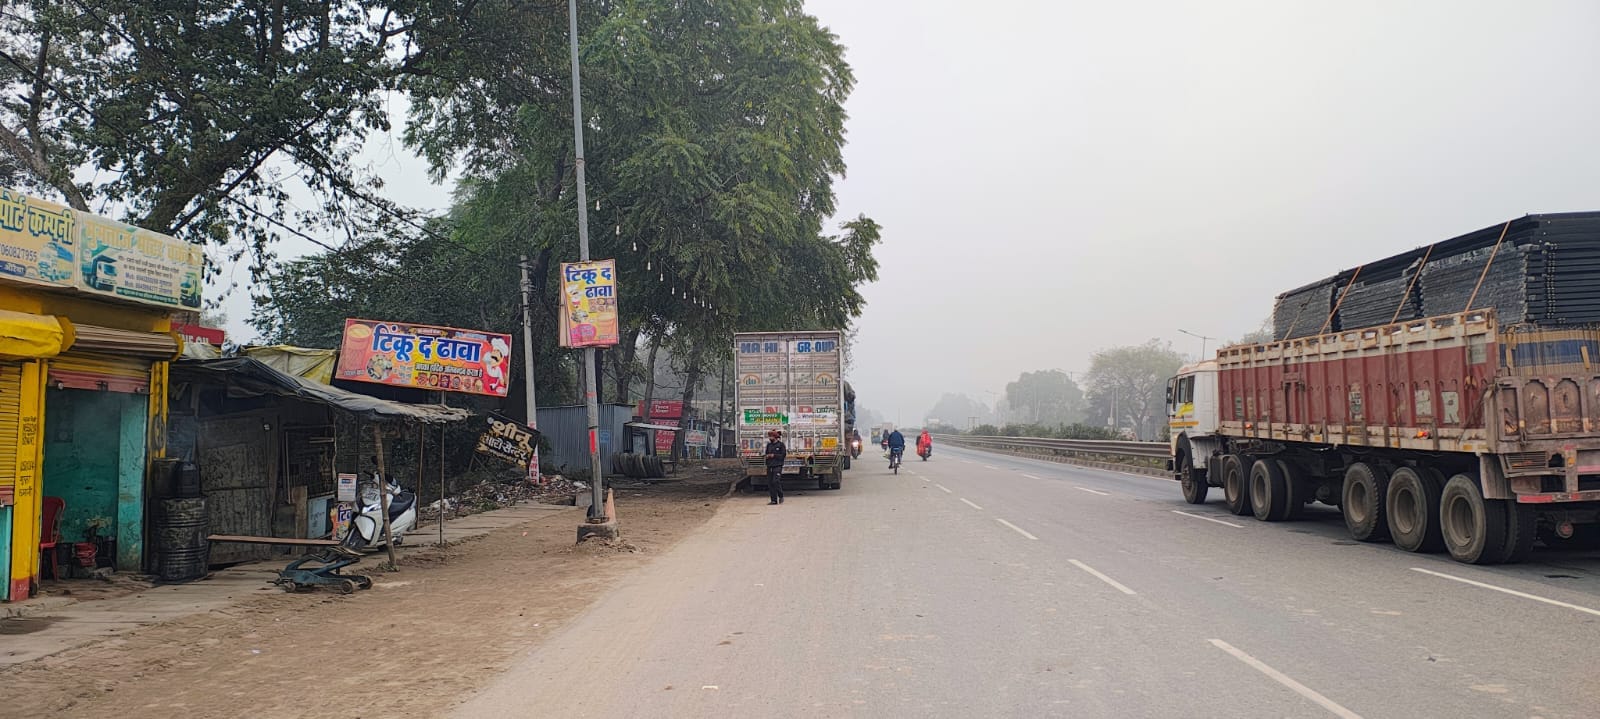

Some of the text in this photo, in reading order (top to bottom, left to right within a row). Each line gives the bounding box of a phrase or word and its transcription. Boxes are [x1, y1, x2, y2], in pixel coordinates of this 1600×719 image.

[601, 267, 611, 280] द
[372, 323, 415, 362] टिंकू
[418, 335, 434, 359] द
